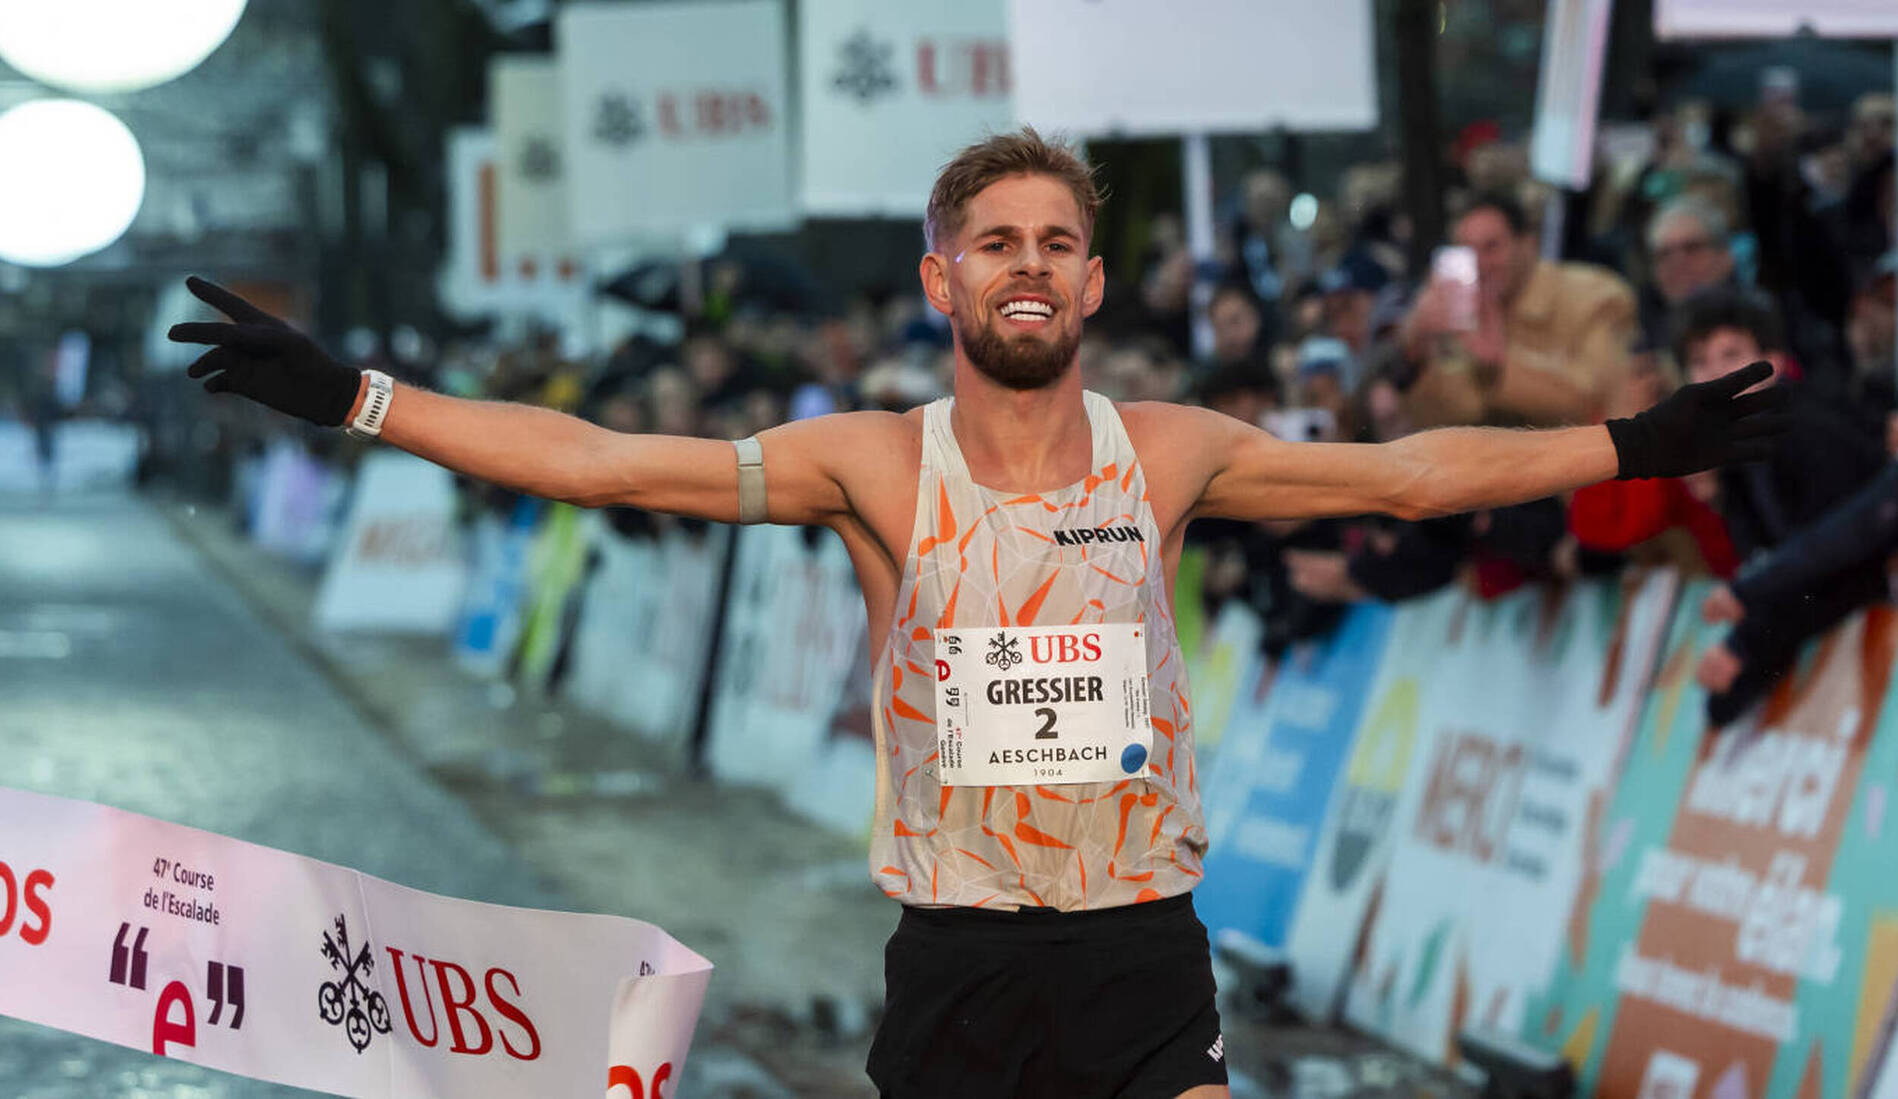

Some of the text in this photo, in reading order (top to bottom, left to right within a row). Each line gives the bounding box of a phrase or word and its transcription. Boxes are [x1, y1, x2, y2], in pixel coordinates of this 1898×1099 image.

[1053, 526, 1145, 547] KIPRUN
[1028, 633, 1102, 664] UBS
[986, 676, 1104, 705] GRESSIER
[1034, 707, 1059, 740] 2
[988, 746, 1108, 764] AESCHBACH
[1033, 769, 1063, 777] 1904
[173, 862, 214, 891] Course
[144, 886, 220, 925] de l'Escalade
[385, 946, 541, 1061] UBS
